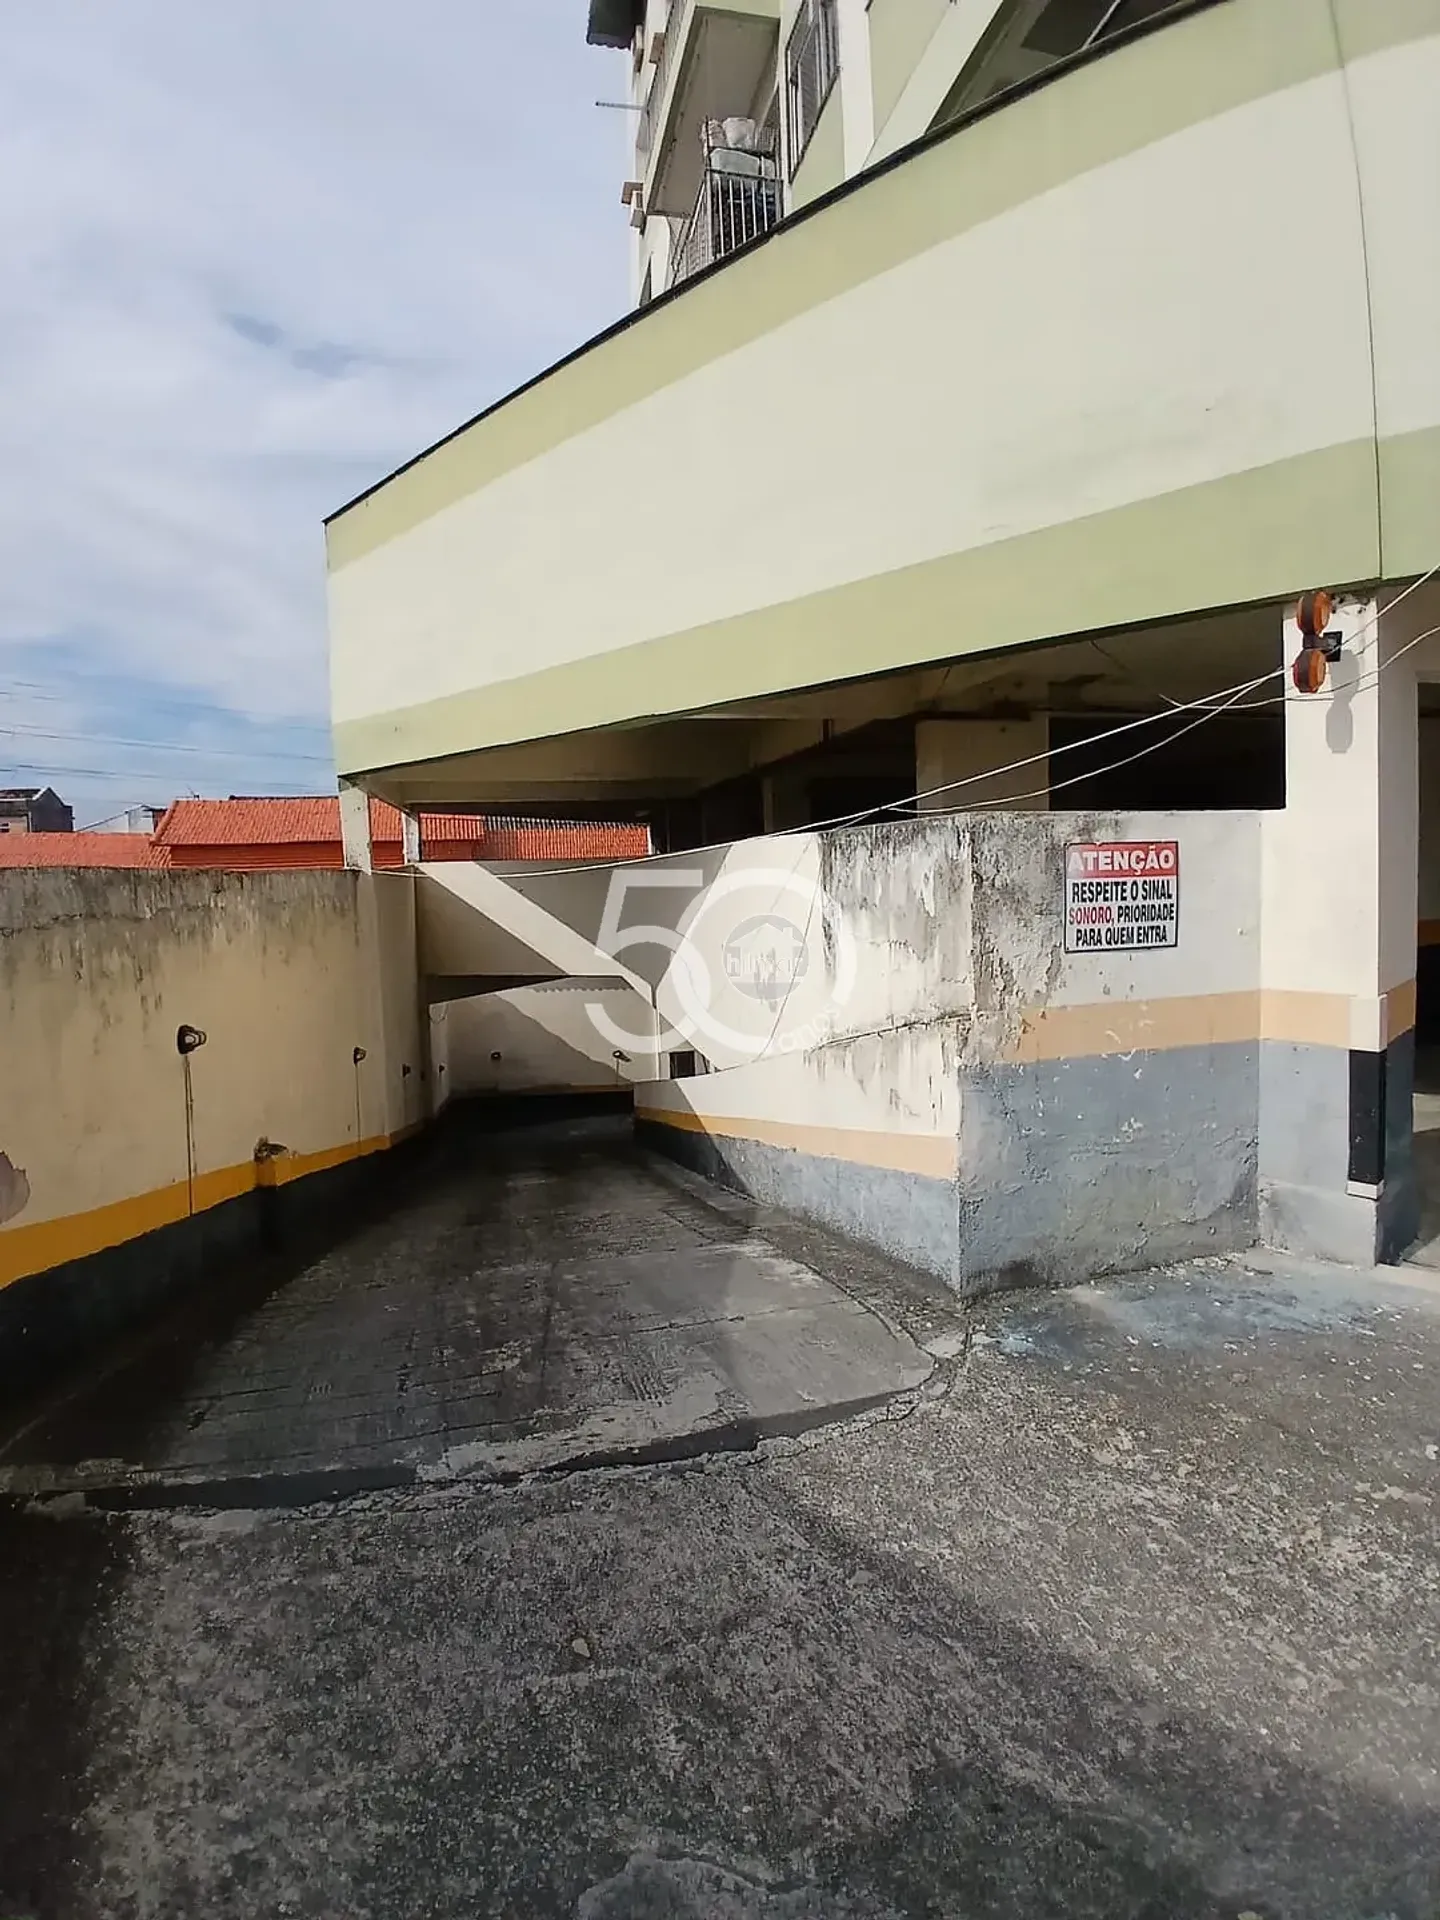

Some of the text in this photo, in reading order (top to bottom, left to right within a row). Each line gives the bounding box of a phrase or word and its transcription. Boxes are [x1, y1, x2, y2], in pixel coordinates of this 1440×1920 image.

[1067, 845, 1175, 876] ATENÇÃO
[1072, 880, 1173, 903] RESPEITE O SINAL
[1069, 903, 1175, 926] SONORO, PRIORIDADE
[1076, 925, 1168, 947] PARA QUEM ENTRA
